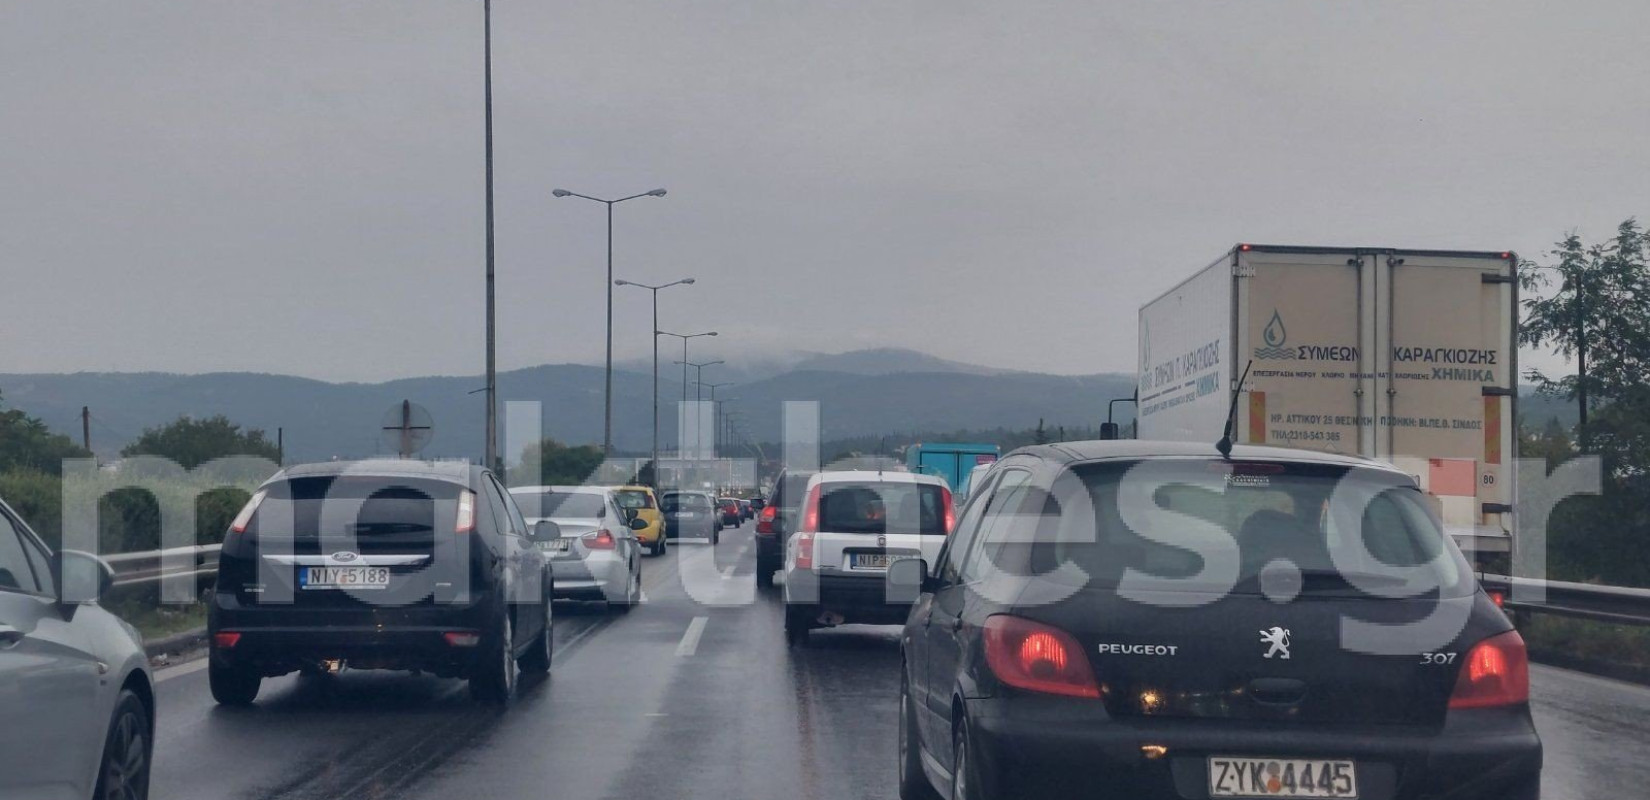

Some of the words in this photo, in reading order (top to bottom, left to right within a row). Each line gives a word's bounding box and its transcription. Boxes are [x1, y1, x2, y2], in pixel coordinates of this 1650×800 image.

[1298, 346, 1359, 361] ΣΥΜΕΩΝ
[1393, 347, 1497, 365] ΚΑΡΑΓΚΙΟΖΗΣ
[1432, 367, 1494, 382] ΧΗΜΙΚΑ
[1286, 414, 1321, 426] ΑΤΤΙΚΟΥ
[1483, 474, 1494, 485] 80
[1099, 643, 1178, 656] PEUGEOT
[1420, 652, 1457, 665] 307
